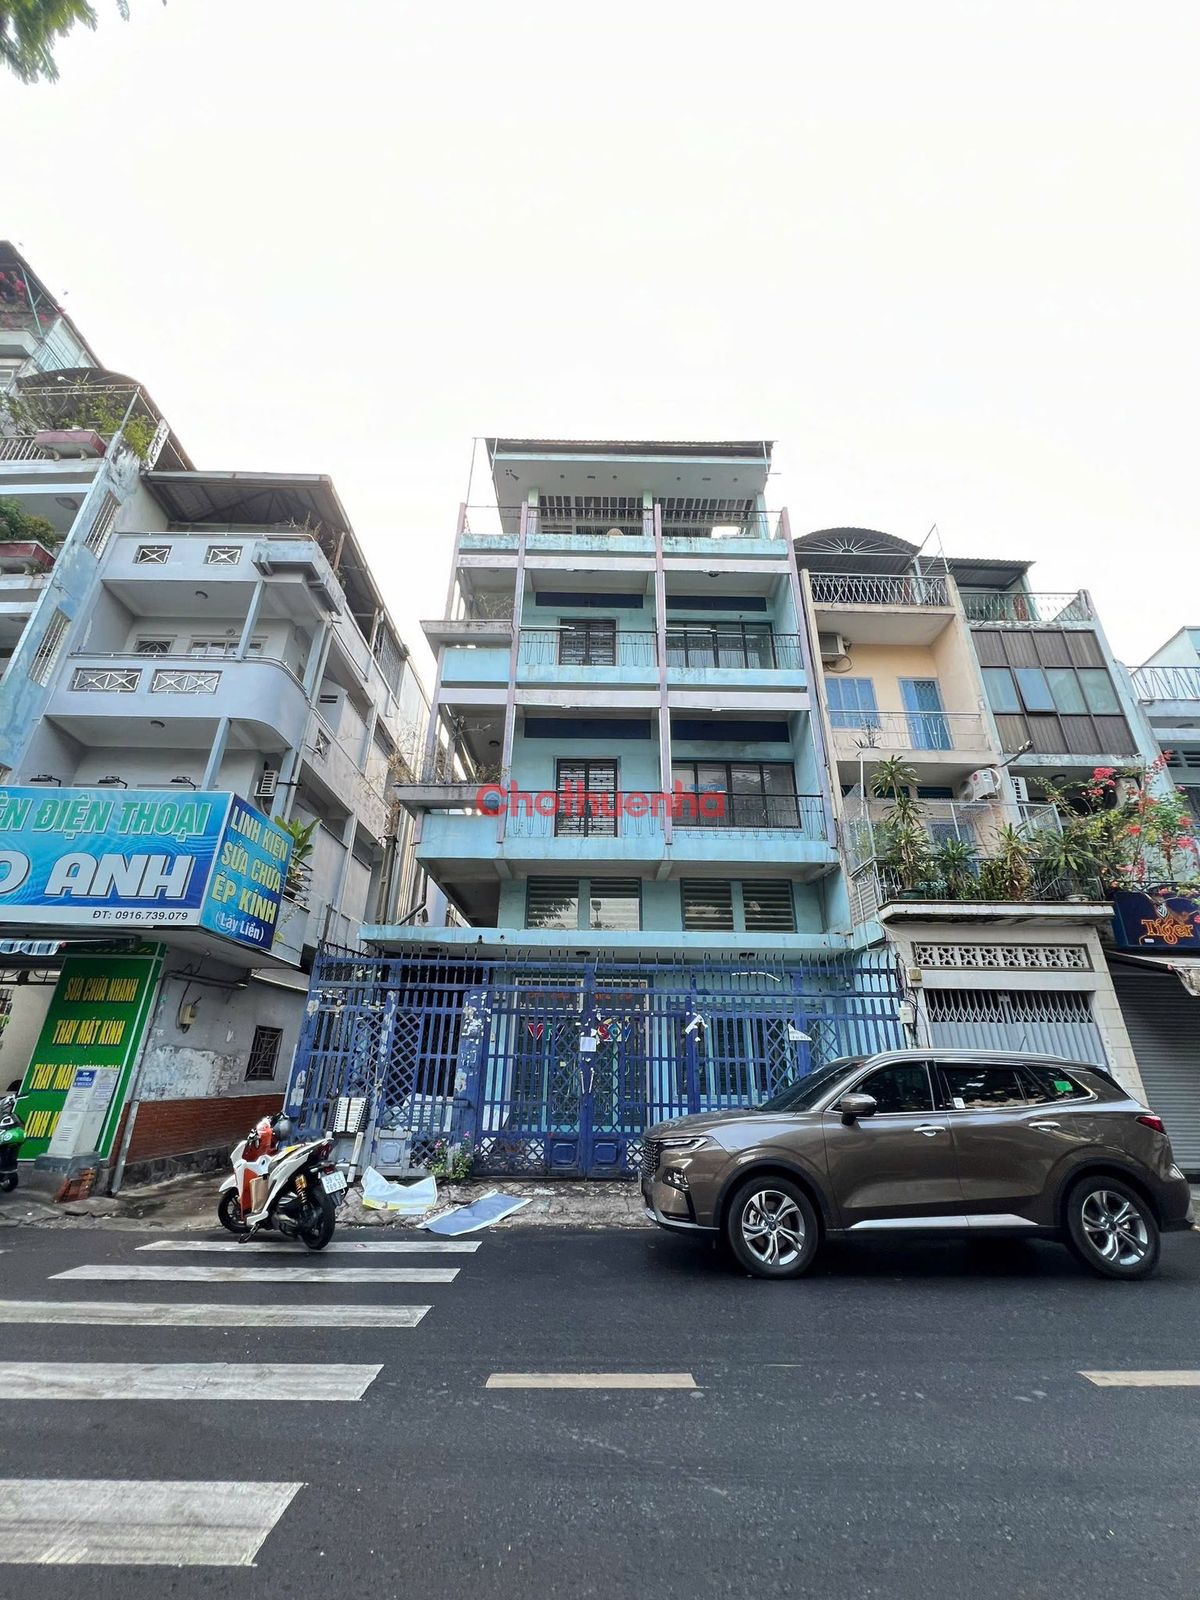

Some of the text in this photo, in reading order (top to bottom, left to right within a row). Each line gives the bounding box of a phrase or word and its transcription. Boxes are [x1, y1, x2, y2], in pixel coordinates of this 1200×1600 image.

[32, 792, 115, 840] ĐIỆN
[118, 801, 212, 842] THOẠI
[230, 805, 289, 863] LINH KIỆN
[44, 851, 196, 898] ANH
[221, 840, 249, 876] SỬA
[92, 910, 188, 920] ĐT: 0916.739.079
[211, 871, 277, 925] ÉP KÍNH
[1141, 918, 1194, 945] Tiger
[52, 1020, 80, 1044] THAY
[29, 1064, 57, 1090] THAY
